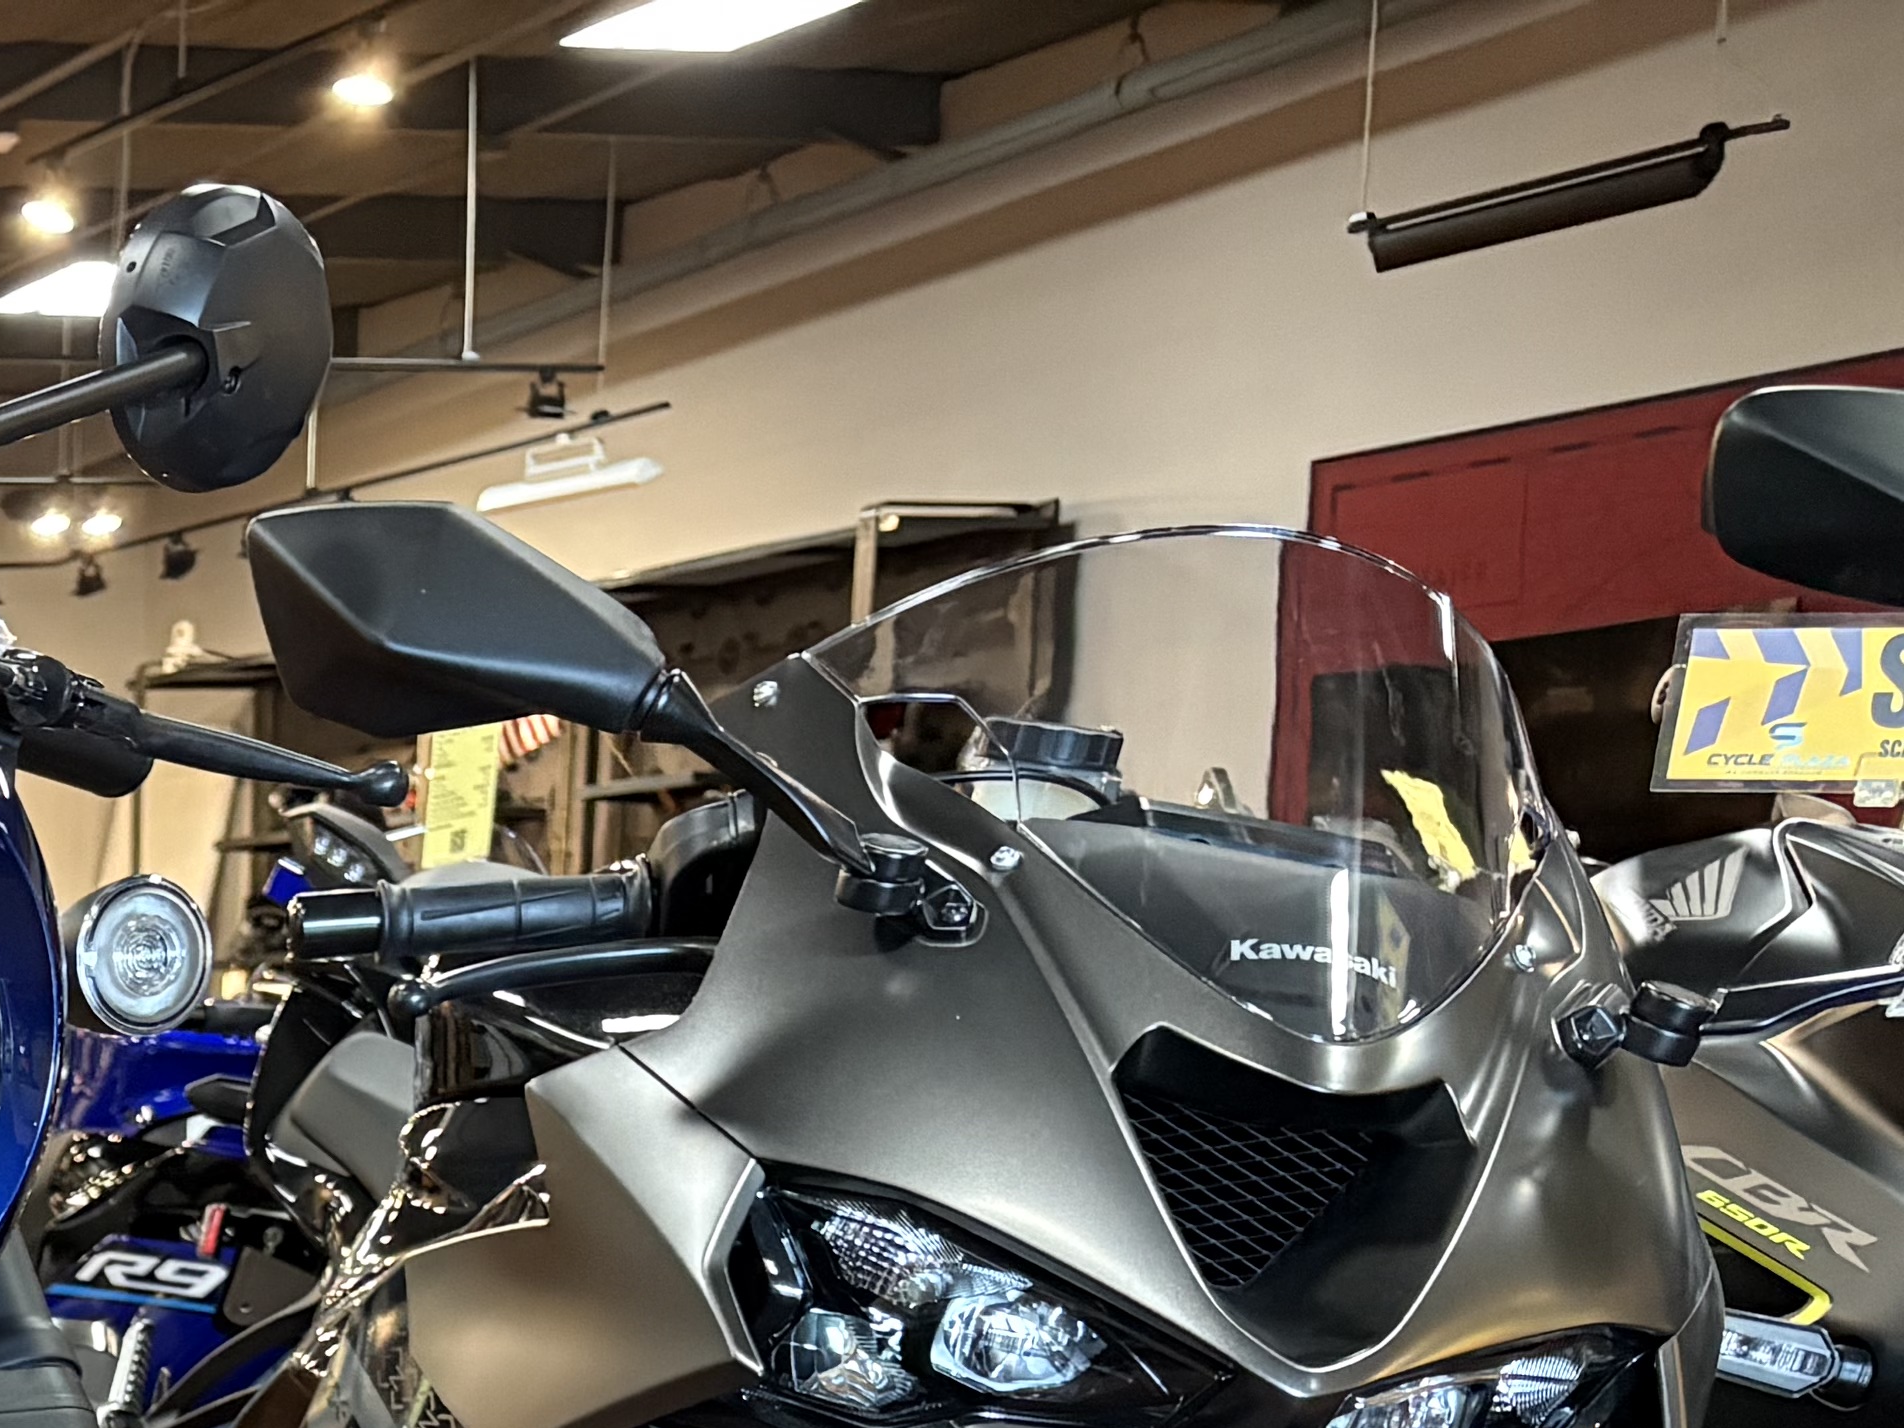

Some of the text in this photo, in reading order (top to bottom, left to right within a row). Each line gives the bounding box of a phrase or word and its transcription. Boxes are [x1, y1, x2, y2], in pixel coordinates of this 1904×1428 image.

[1706, 753, 1775, 766] CYCLE
[1229, 938, 1398, 989] Kawaaki
[1680, 1145, 1878, 1273] CBR
[1695, 1189, 1811, 1260] 650R
[74, 1251, 230, 1299] R9
